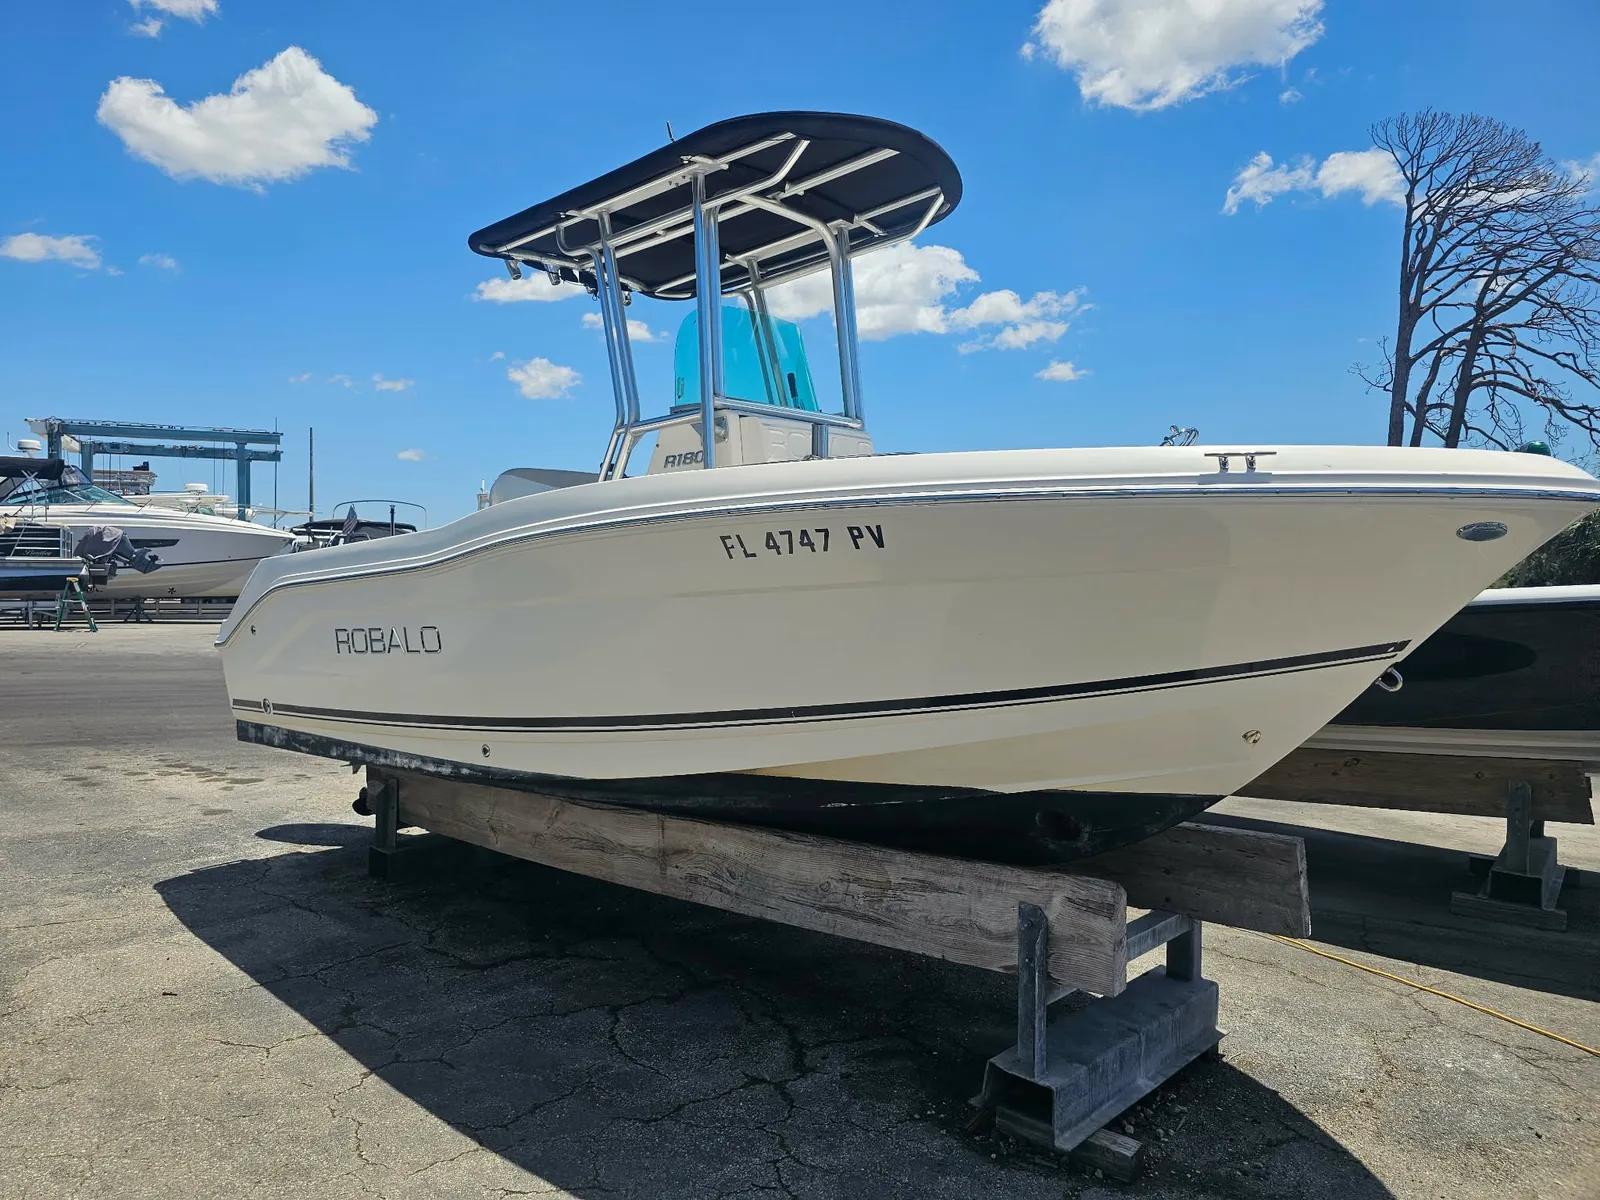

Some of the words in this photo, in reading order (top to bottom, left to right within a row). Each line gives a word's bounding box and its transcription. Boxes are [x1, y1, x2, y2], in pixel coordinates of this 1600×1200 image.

[664, 450, 704, 468] R180
[719, 534, 757, 560] FL
[764, 528, 830, 556] 4747
[846, 524, 885, 550] PV
[335, 626, 442, 654] ROBALO
